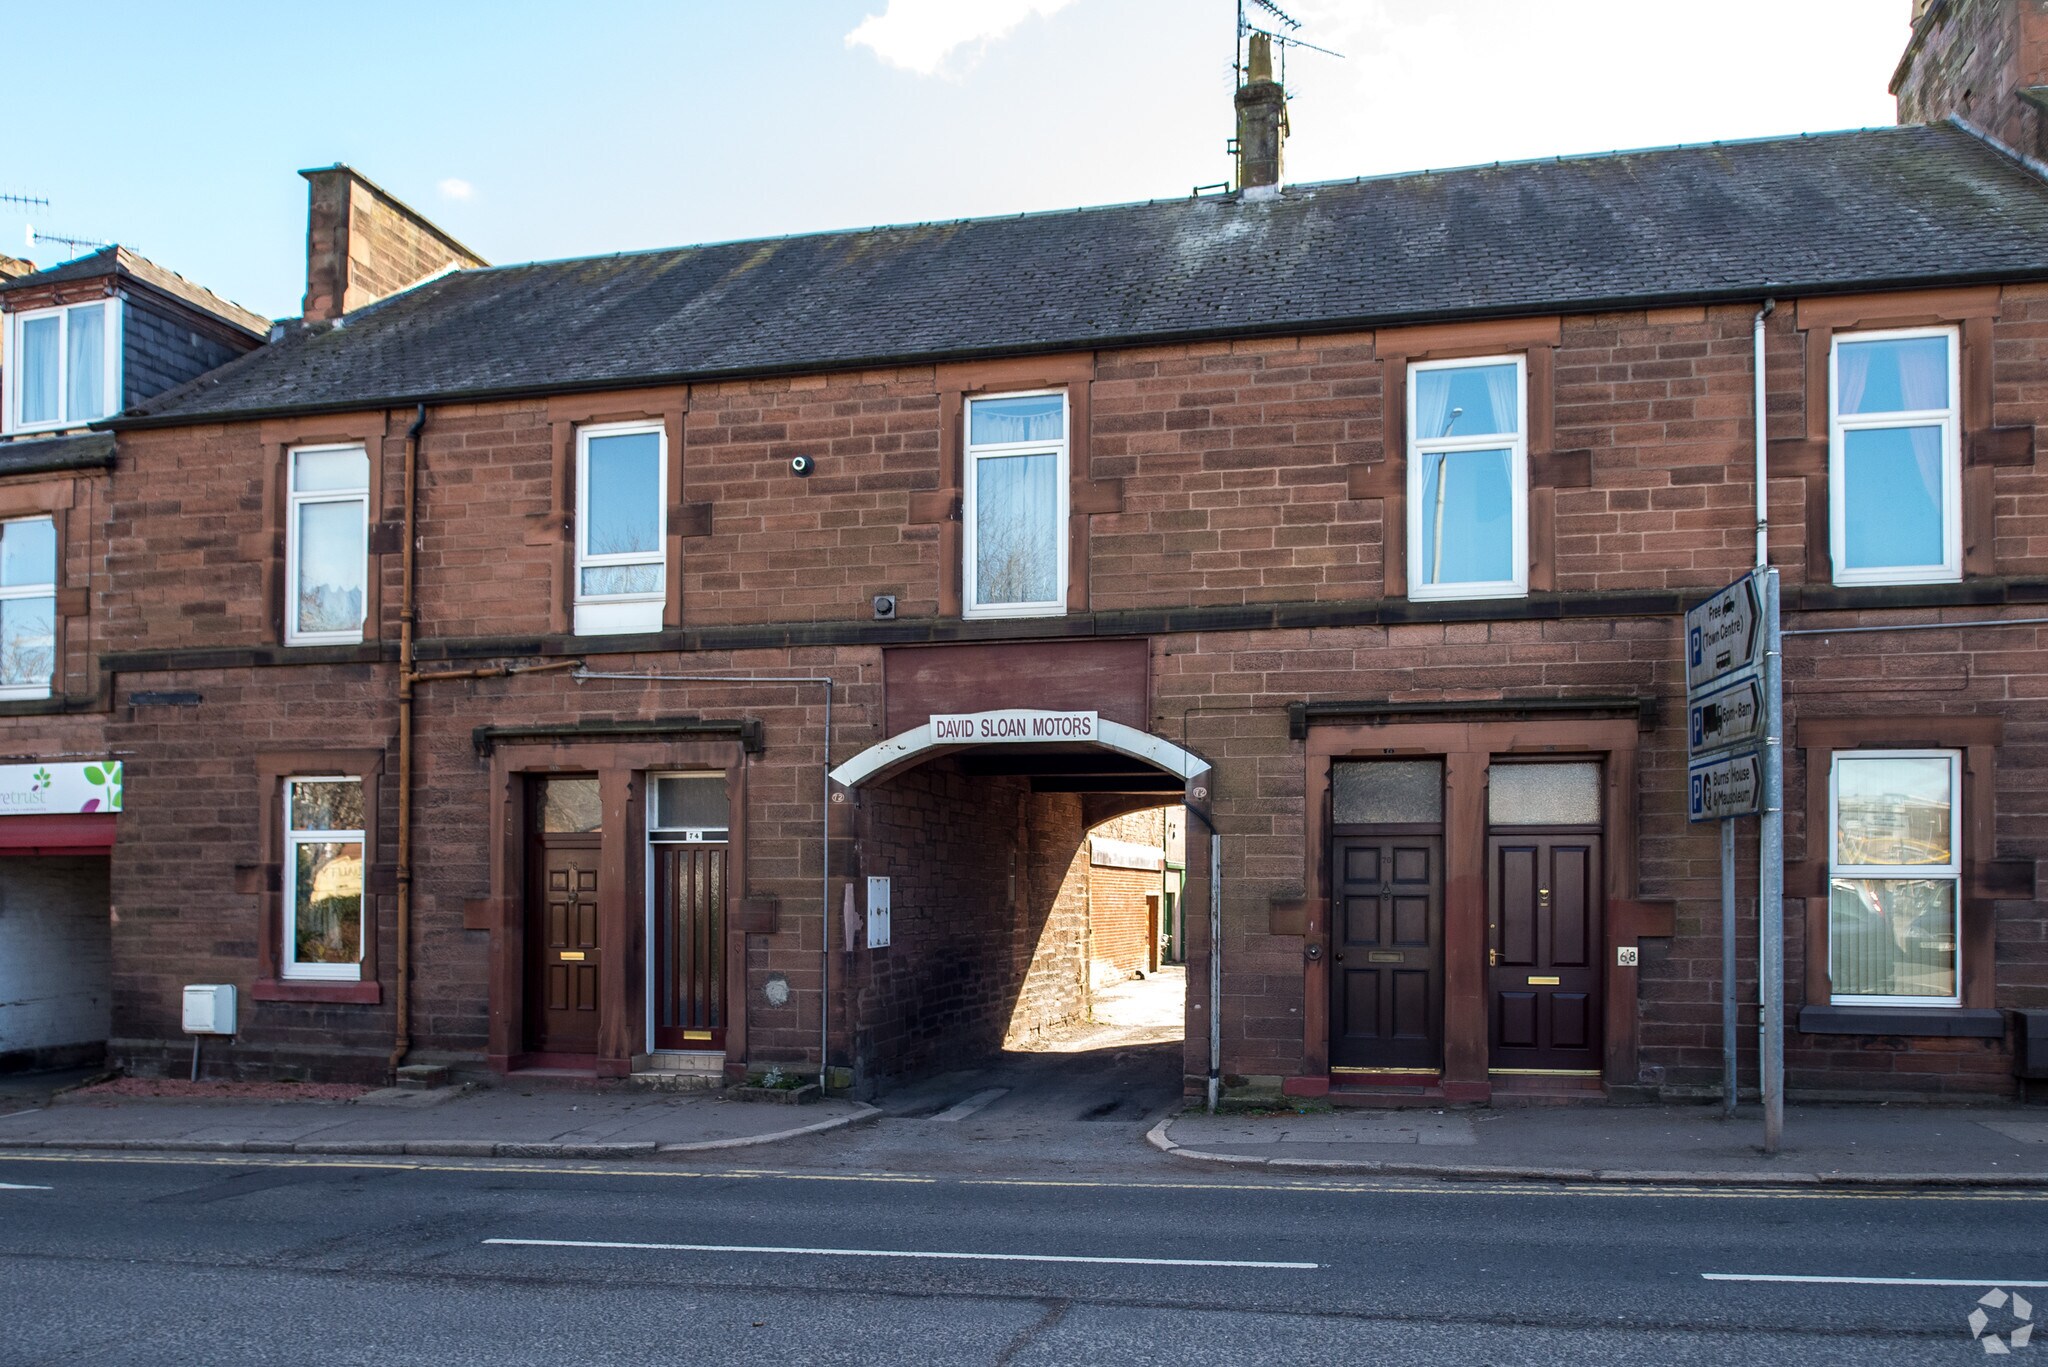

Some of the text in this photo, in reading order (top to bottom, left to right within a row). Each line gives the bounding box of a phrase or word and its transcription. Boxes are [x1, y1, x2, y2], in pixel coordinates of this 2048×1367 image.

[1709, 604, 1721, 622] Free
[1703, 614, 1743, 652] (Town Centre)
[1692, 631, 1700, 665] P
[937, 716, 1091, 738] DAVID SLOAN MOTORS
[1693, 712, 1701, 744] P
[1731, 767, 1750, 783] House
[1693, 779, 1701, 810] P
[689, 832, 700, 840] 74
[1382, 856, 1392, 864] 70
[1620, 951, 1637, 963] 68
